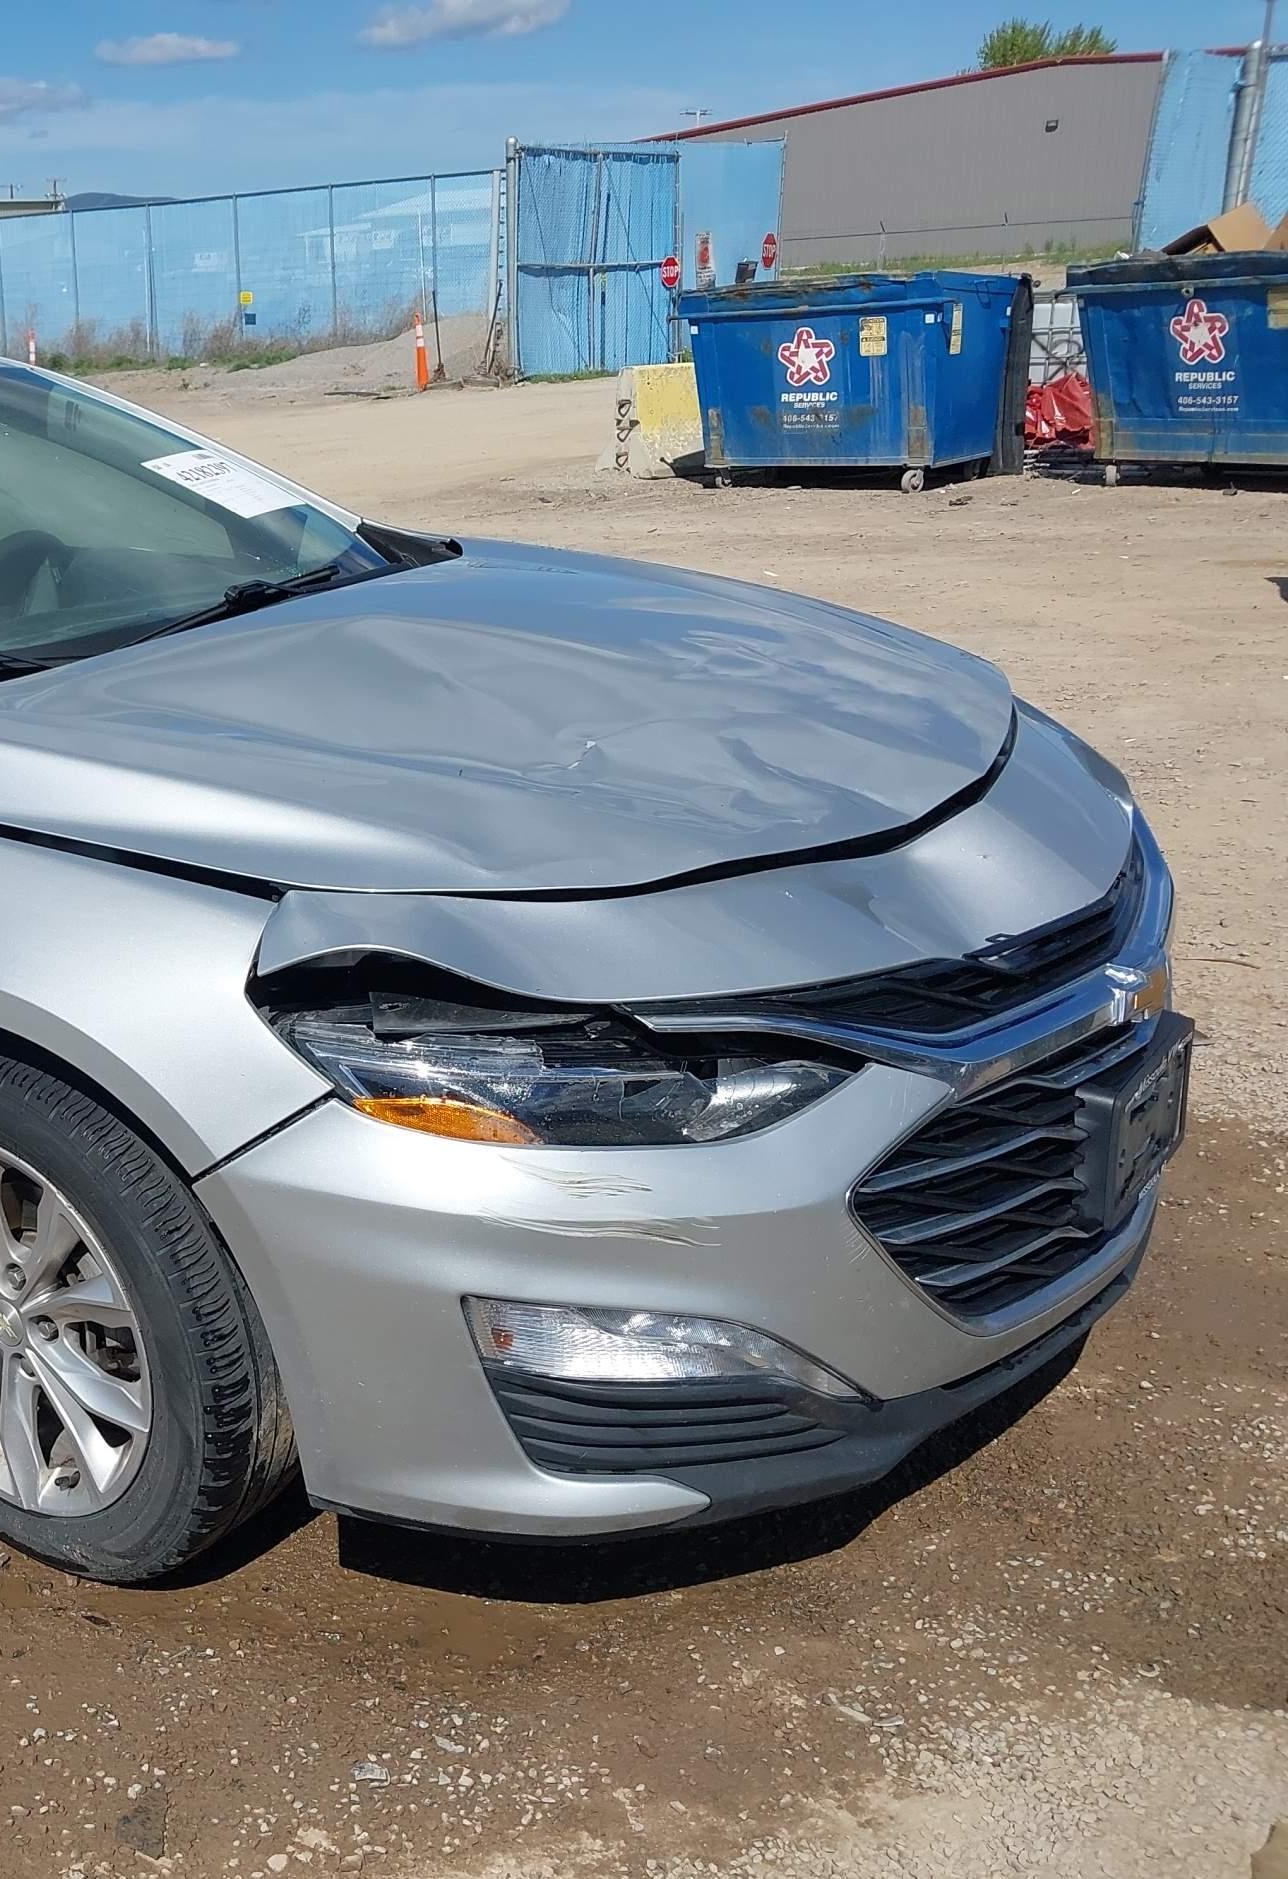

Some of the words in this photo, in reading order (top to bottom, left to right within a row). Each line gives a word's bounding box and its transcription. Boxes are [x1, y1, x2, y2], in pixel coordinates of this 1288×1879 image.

[762, 243, 776, 257] STOP
[662, 265, 679, 278] STOP
[1175, 371, 1236, 382] REPUBLIC
[1188, 382, 1222, 390] SERVICES
[780, 391, 838, 403] REPUBLIC
